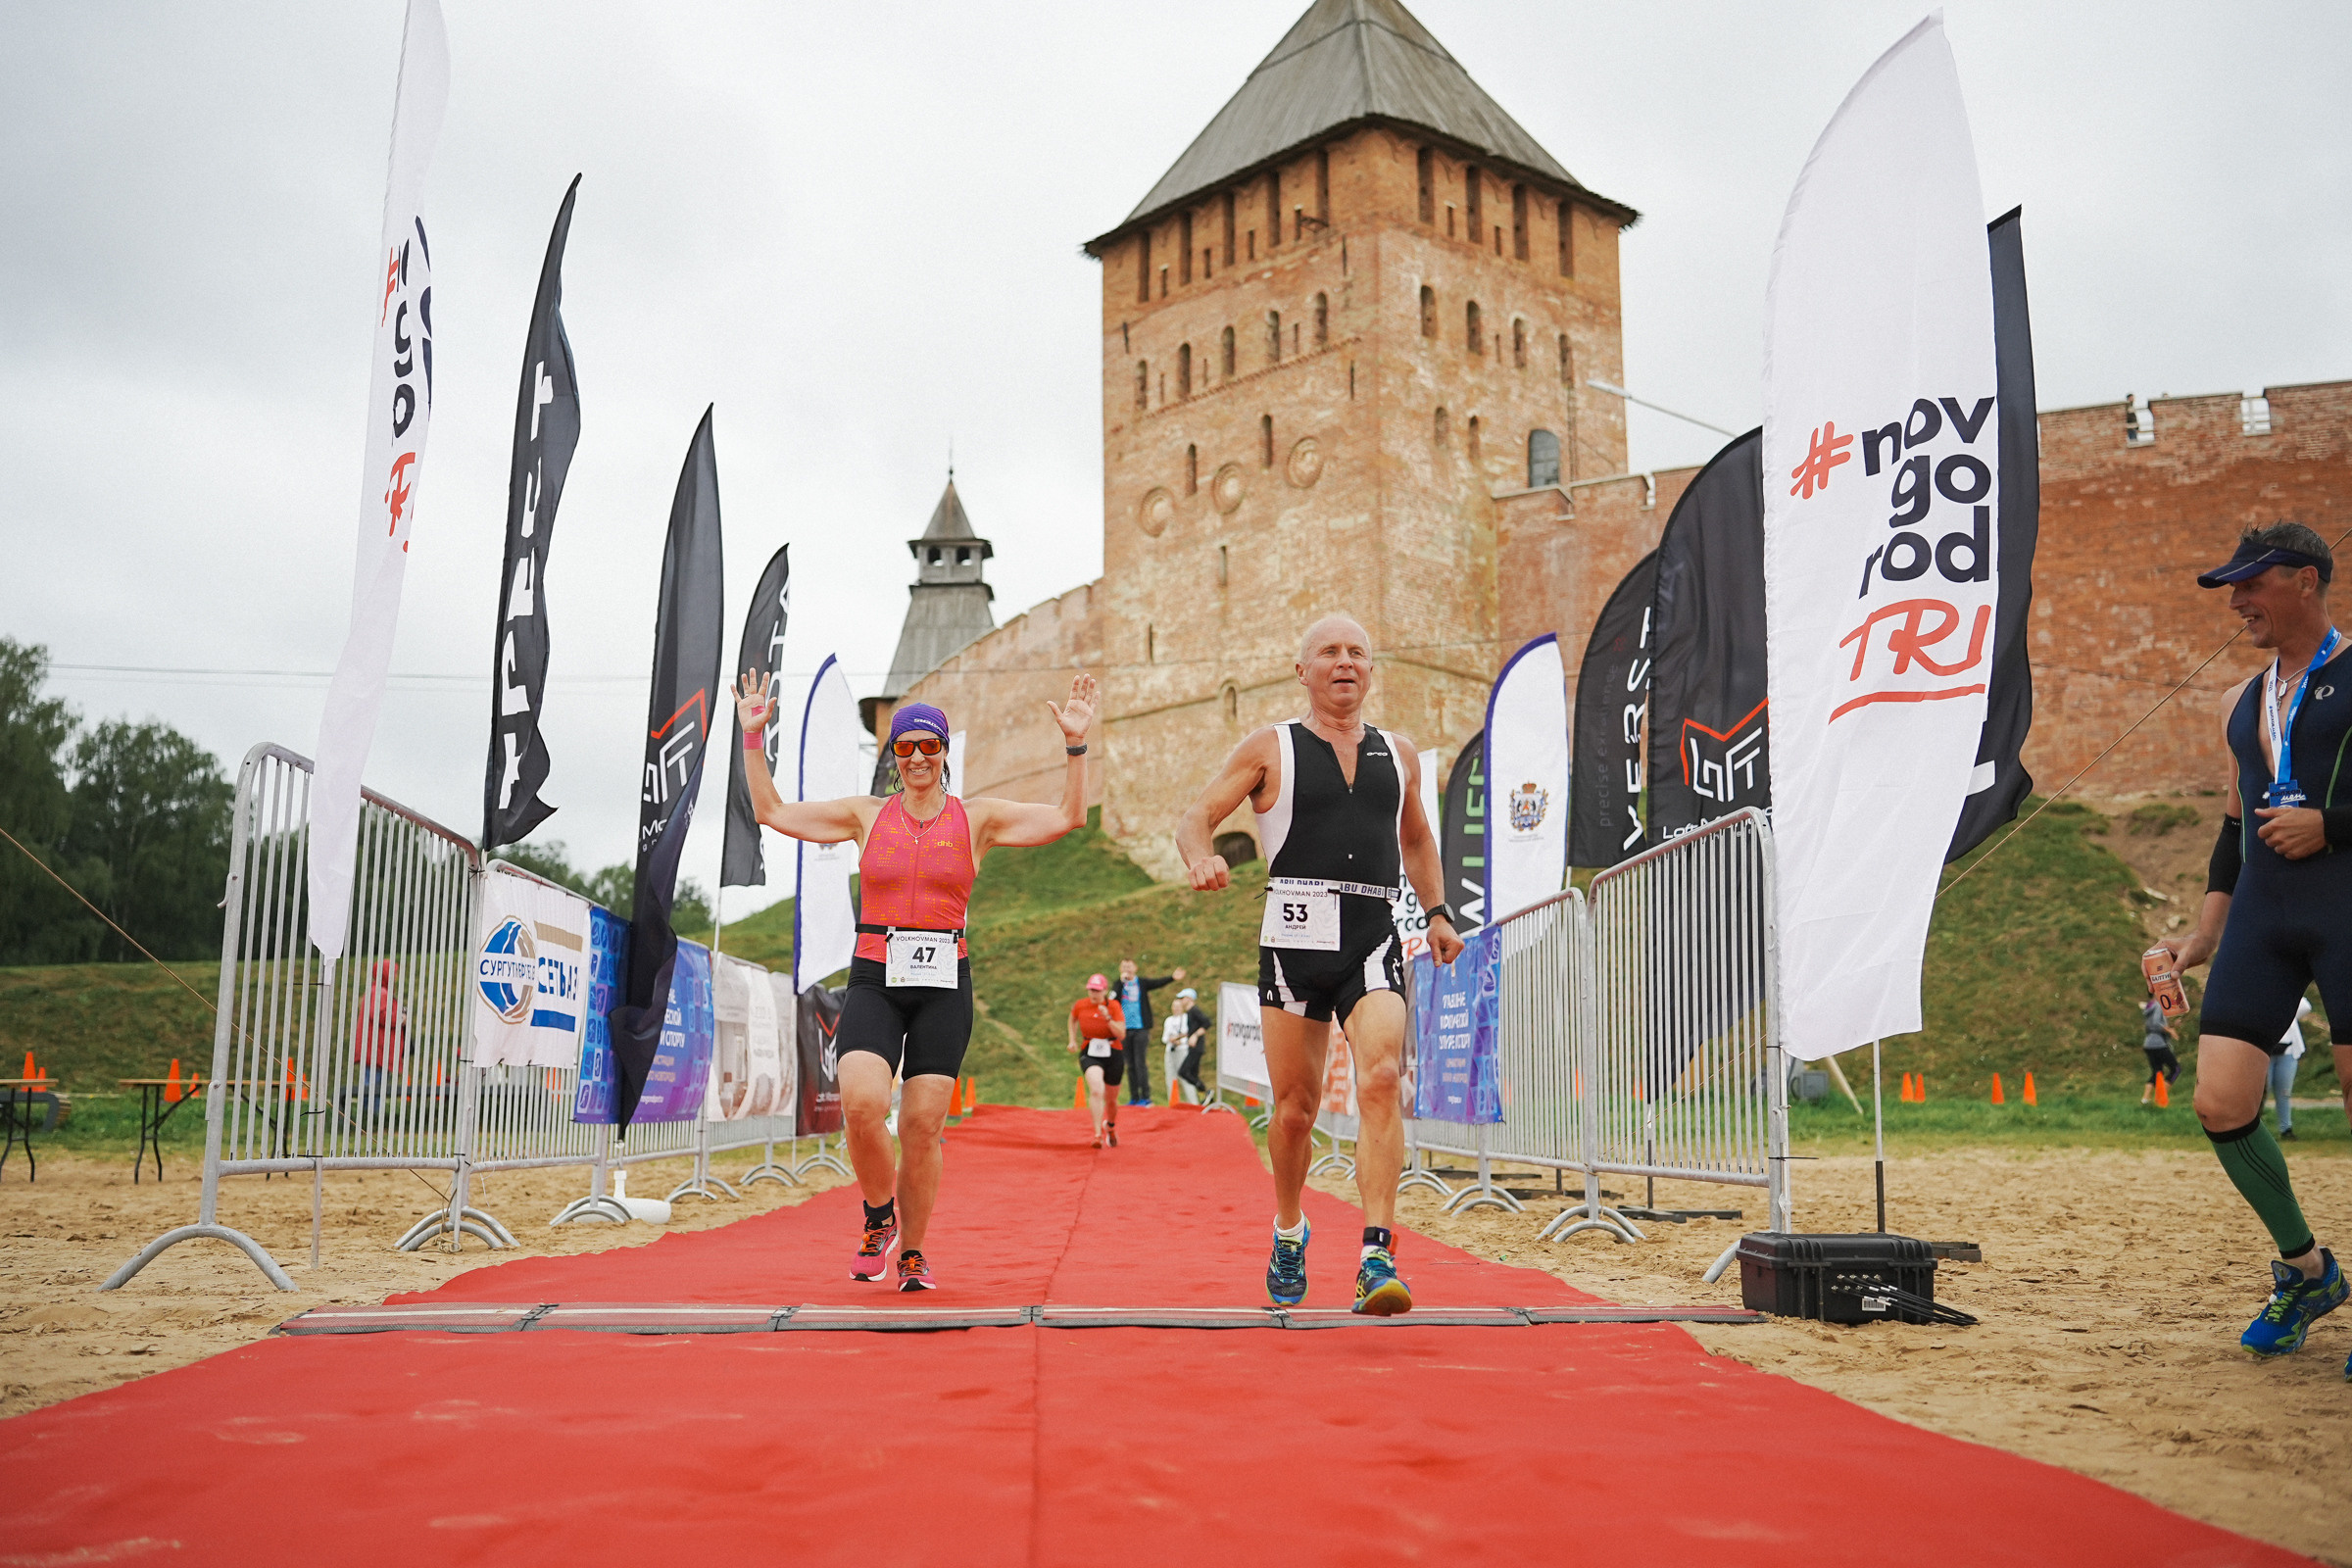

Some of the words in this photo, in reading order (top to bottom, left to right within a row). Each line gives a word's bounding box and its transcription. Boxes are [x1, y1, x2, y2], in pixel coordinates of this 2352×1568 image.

[1888, 453, 1992, 528] go
[1858, 505, 1990, 600] rod
[1838, 599, 1992, 681] TRI
[1283, 903, 1308, 922] 53
[1361, 885, 1384, 897] DHABI
[912, 947, 936, 963] 47
